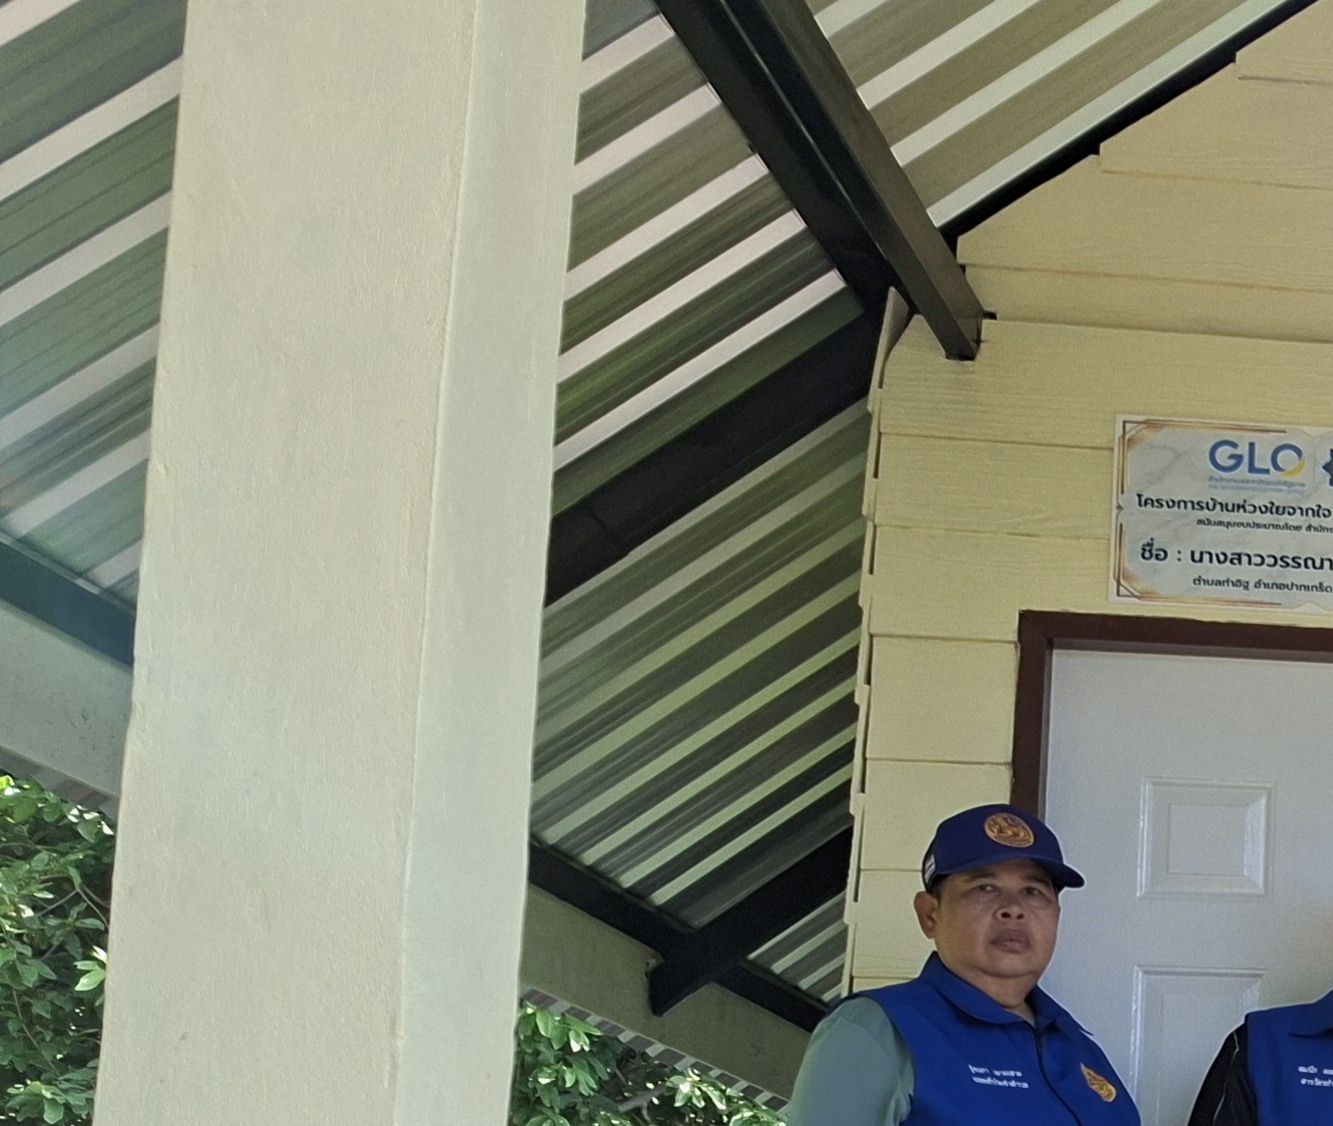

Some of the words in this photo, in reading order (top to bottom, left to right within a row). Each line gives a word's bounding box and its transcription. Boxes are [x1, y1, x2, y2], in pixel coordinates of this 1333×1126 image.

[1209, 440, 1306, 478] GLO
[1136, 493, 1332, 519] โครงการบ้านห่วงใยจากใจ
[1140, 538, 1168, 562] ชื่อ
[1190, 550, 1333, 571] นางสาววรรณา
[1254, 579, 1333, 594] อำเภอปากเกร็ด
